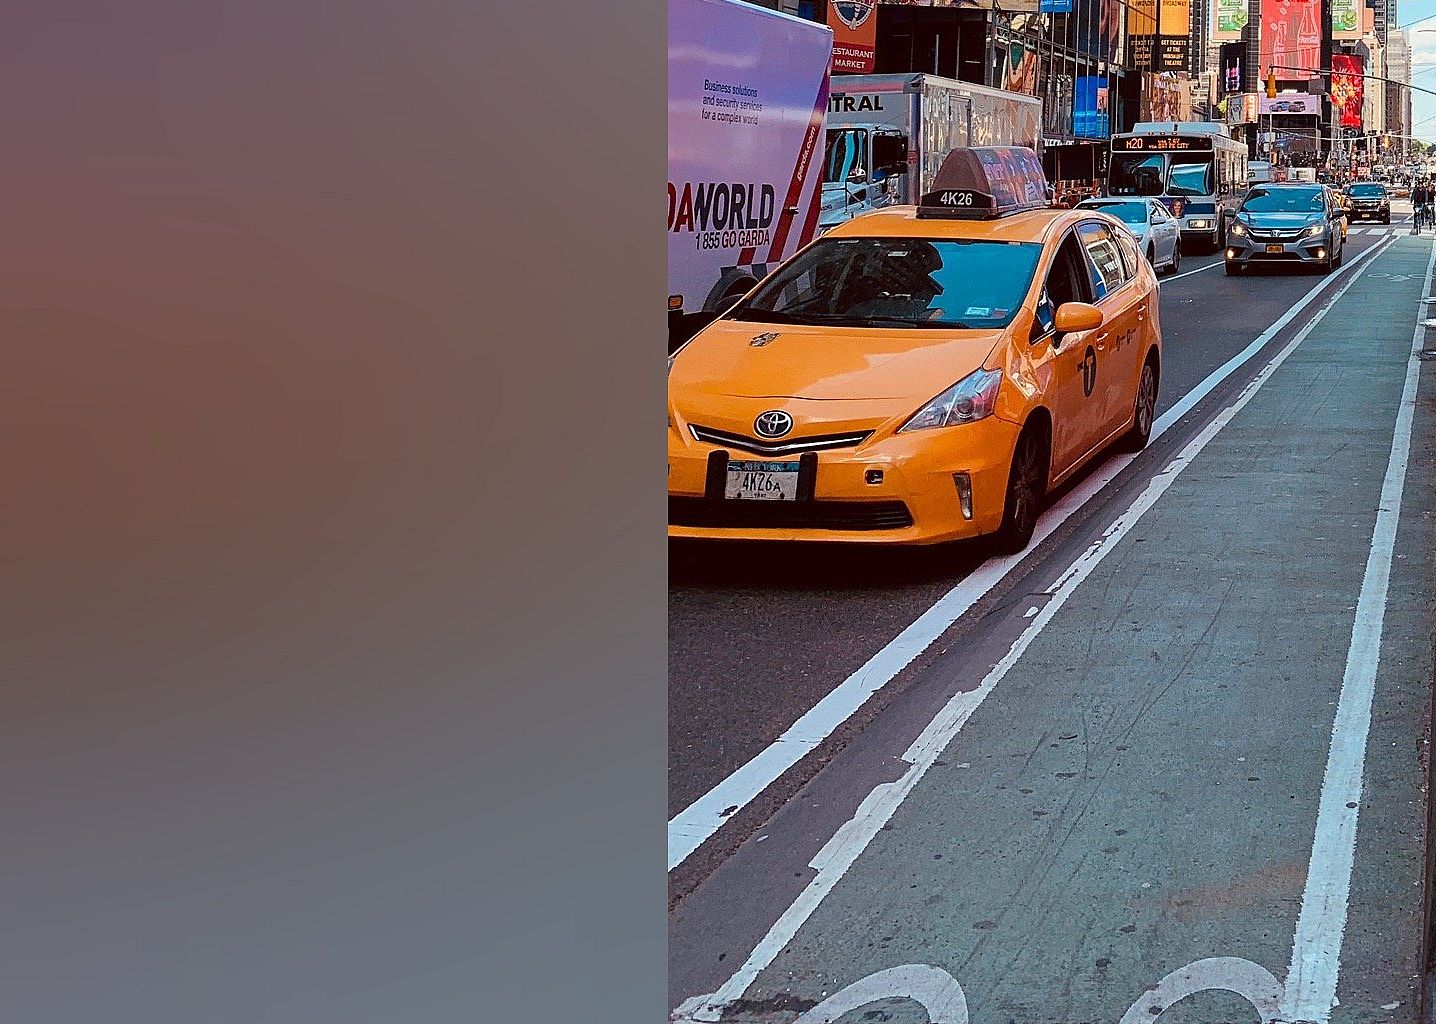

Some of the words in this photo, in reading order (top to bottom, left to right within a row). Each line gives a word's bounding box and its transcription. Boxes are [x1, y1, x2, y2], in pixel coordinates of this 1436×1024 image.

[832, 47, 874, 59] ESTAURANT
[834, 59, 866, 69] MARKET
[704, 79, 732, 94] Business
[732, 84, 758, 98] solutions
[702, 95, 715, 106] and
[715, 97, 740, 110] security
[739, 101, 763, 112] services
[701, 108, 711, 120] for
[717, 112, 742, 125] complex
[940, 191, 973, 206] 4K26
[695, 233, 700, 250] 1
[702, 232, 719, 250] 855
[721, 231, 737, 248] GO
[737, 229, 770, 247] GARDA
[742, 472, 781, 492] 4K26A
